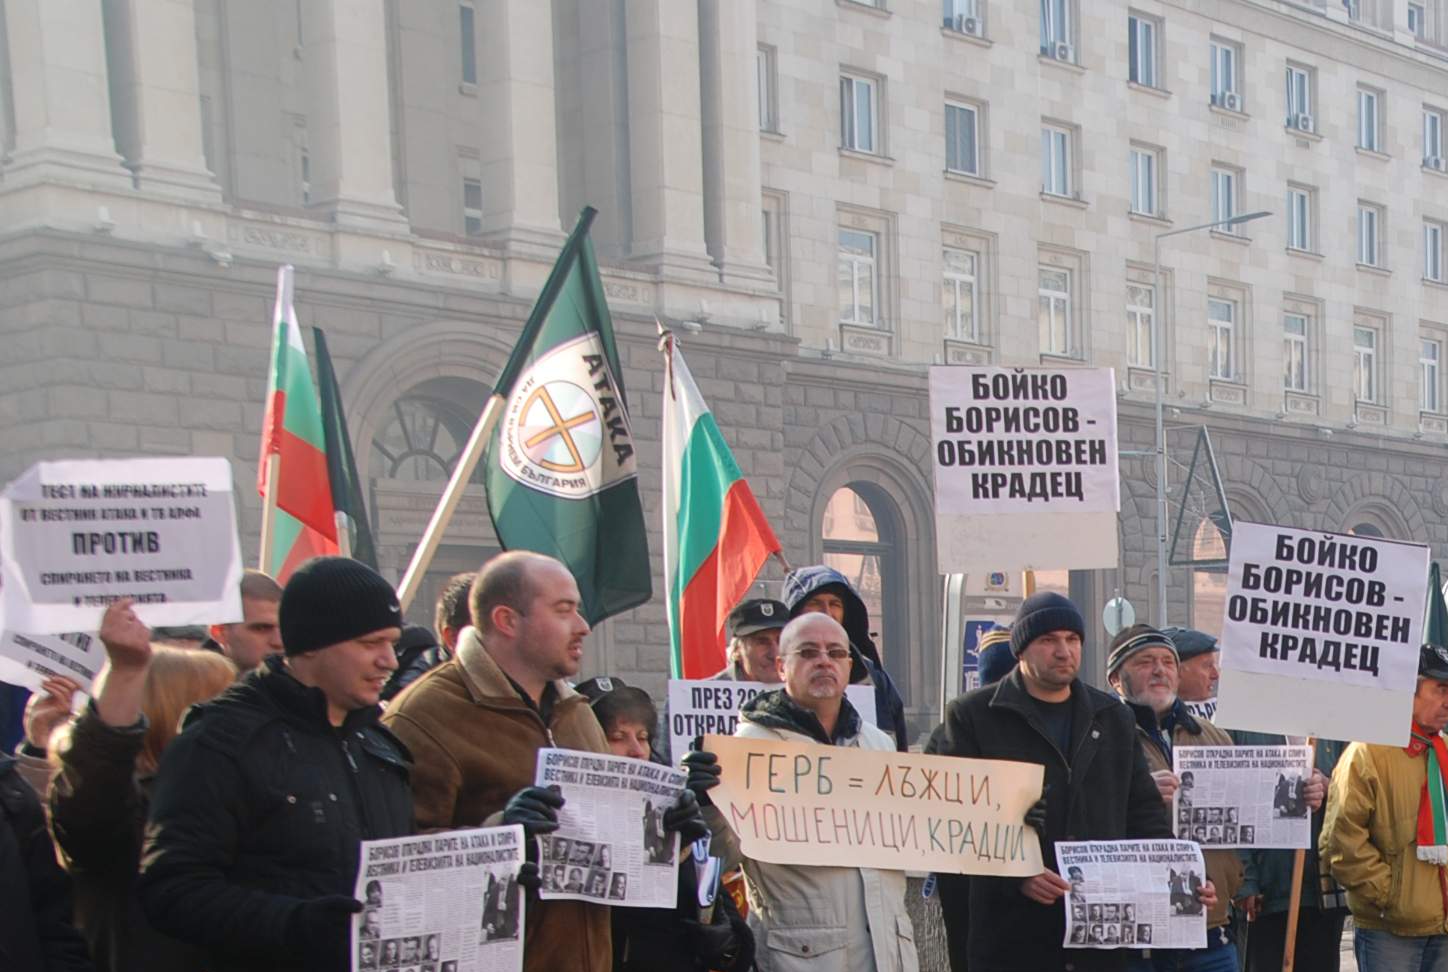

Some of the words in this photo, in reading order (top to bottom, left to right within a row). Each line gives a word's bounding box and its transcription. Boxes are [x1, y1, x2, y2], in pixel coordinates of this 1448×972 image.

[971, 368, 1067, 400] БОЙКО
[582, 354, 633, 466] АТАКА
[945, 406, 1080, 433] БОРИСОВ
[937, 439, 1107, 467] ОБИКНОВЕН
[521, 465, 586, 488] БЪЛГАРИЯ
[971, 471, 1085, 502] КРАДЕЦ
[81, 484, 98, 499] НА
[101, 508, 136, 520] АТАКА
[72, 532, 160, 555] ПРОТИВ
[1275, 534, 1378, 574] БОЙКО
[40, 570, 113, 585] СПИРАНЕТО
[115, 570, 131, 582] НА
[134, 568, 193, 582] ВЕСТНИКА
[1241, 562, 1386, 607] БОРИСОВ
[1228, 594, 1411, 644] ОБИКНОВЕН
[1259, 631, 1380, 677] КРАДЕЦ
[692, 687, 732, 709] ПРЕЗ
[637, 764, 659, 781] АТАКА
[745, 752, 833, 795] ГЕРБ
[875, 764, 1001, 810] ЛЪЖЦИ,
